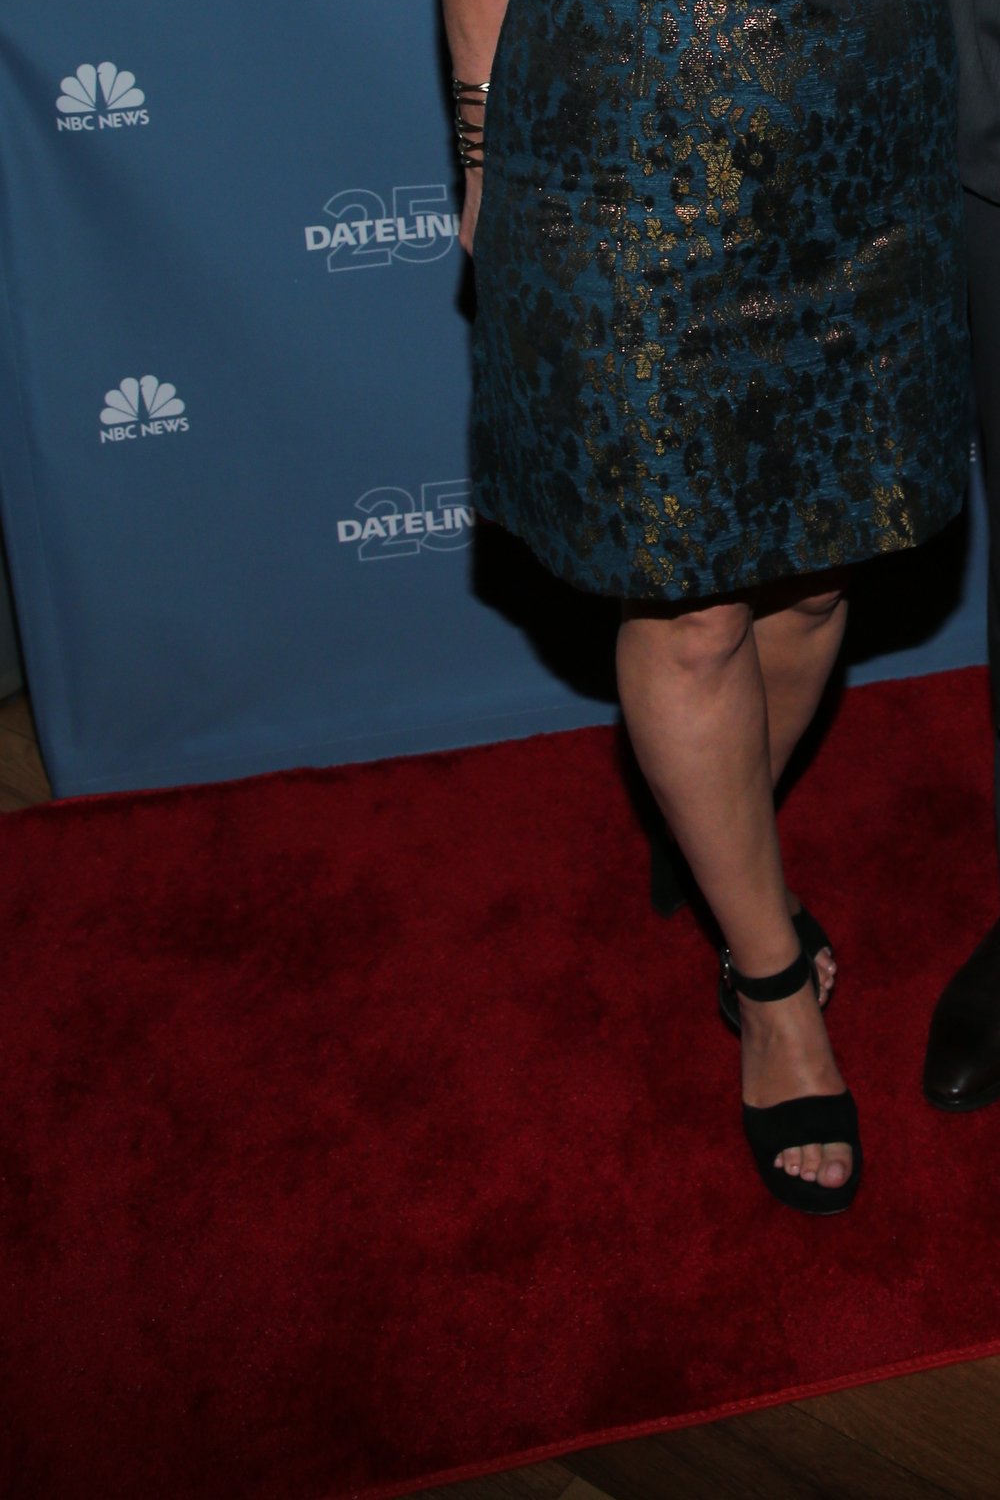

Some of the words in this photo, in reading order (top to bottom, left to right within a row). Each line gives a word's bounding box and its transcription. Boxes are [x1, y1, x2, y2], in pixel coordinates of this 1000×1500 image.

[56, 114, 95, 132] NBC
[98, 109, 150, 129] NEWS
[323, 184, 454, 273] 25
[100, 423, 137, 444] NBC
[141, 416, 190, 437] NEWS
[337, 507, 477, 543] DATELIN
